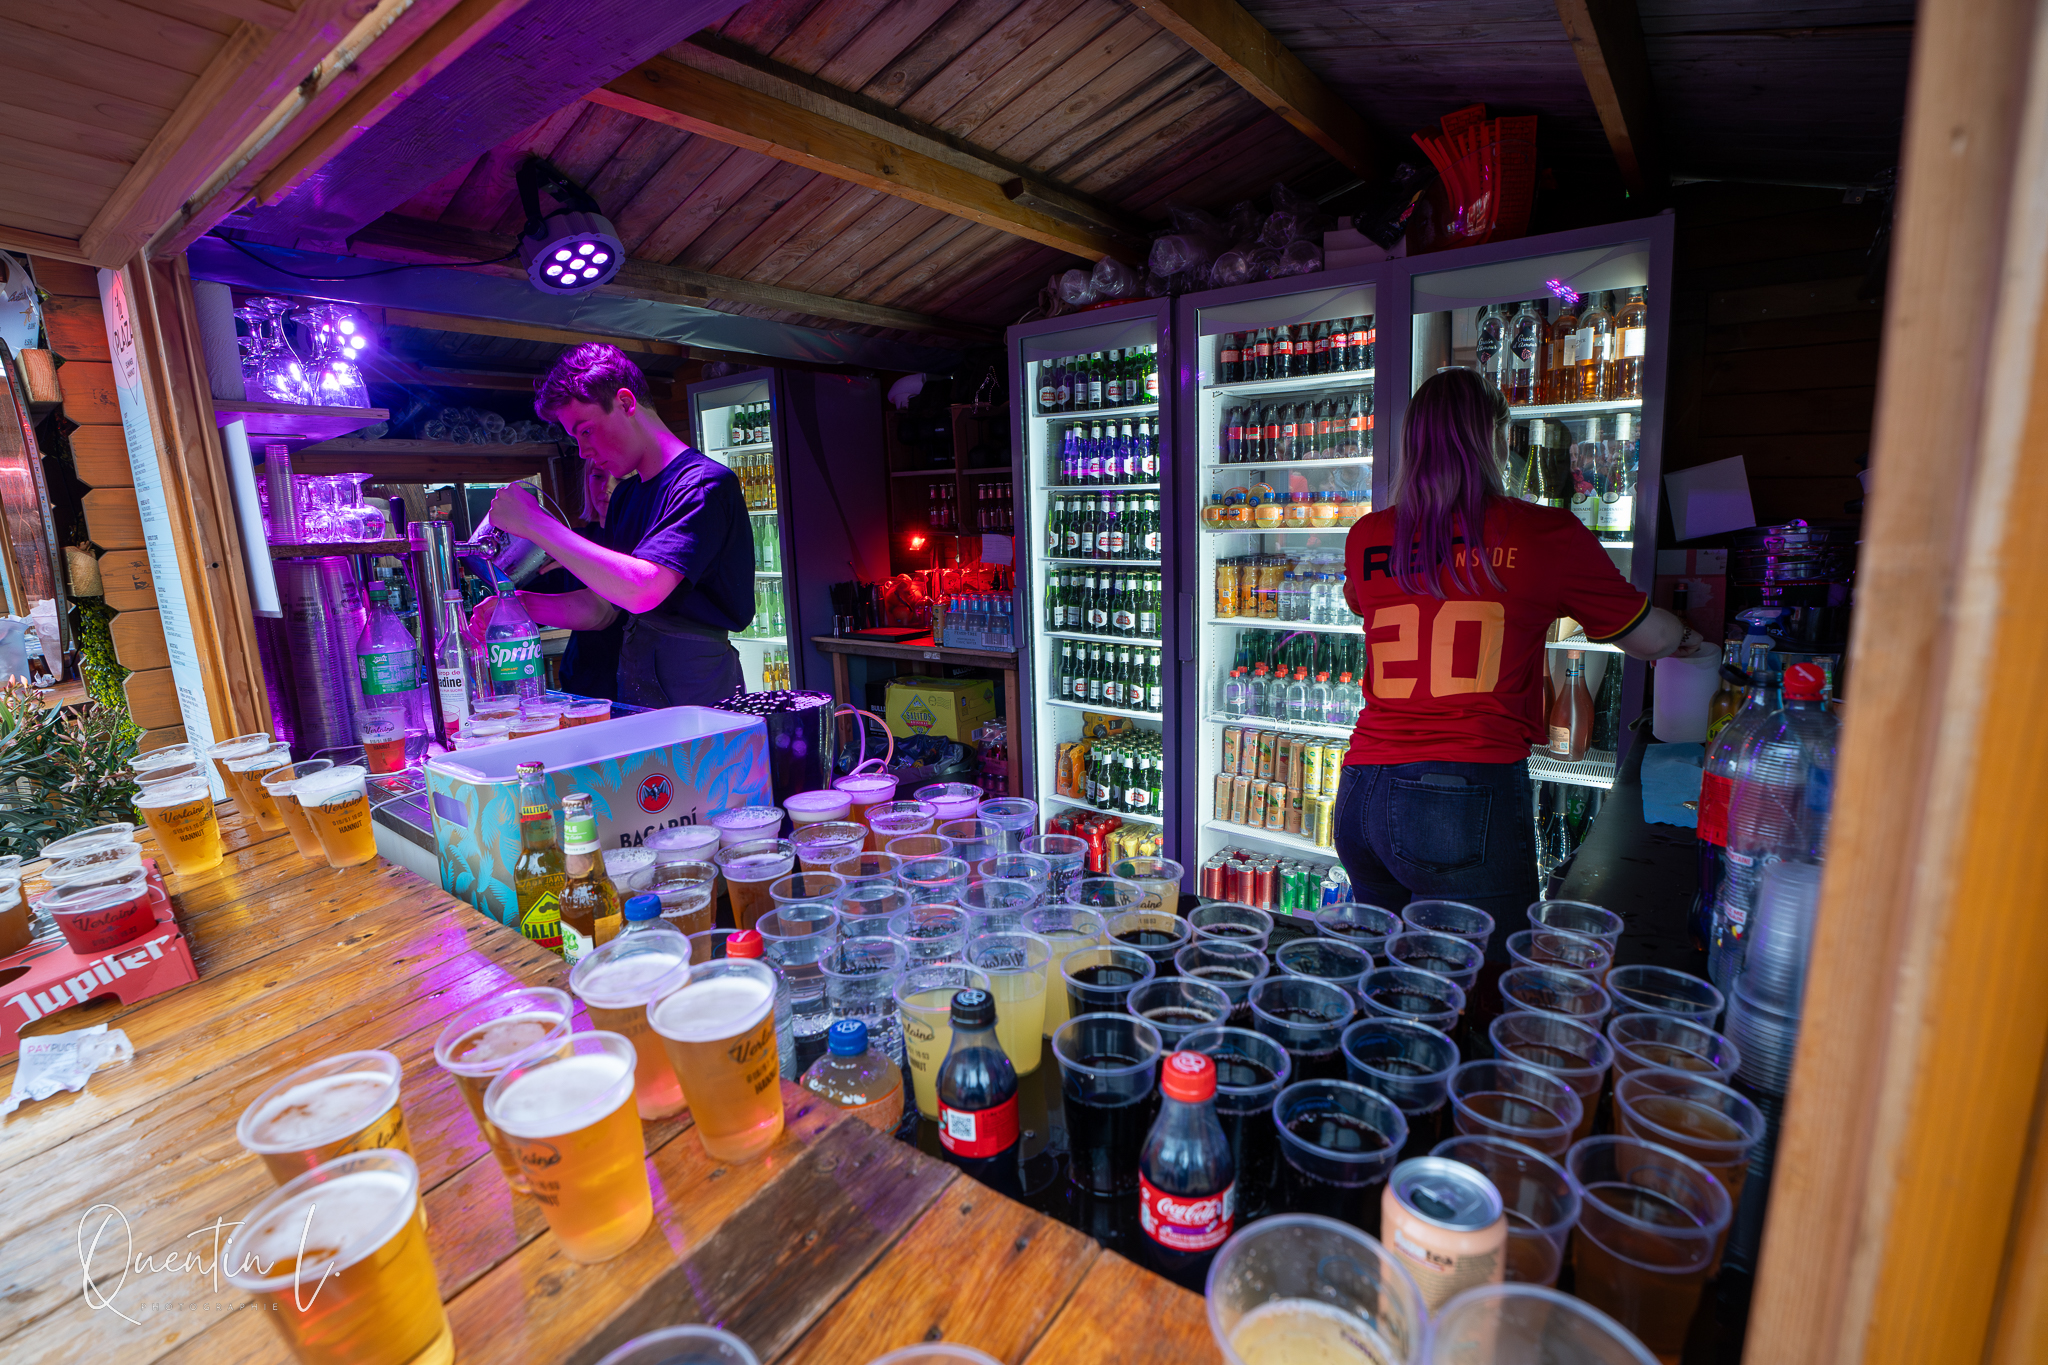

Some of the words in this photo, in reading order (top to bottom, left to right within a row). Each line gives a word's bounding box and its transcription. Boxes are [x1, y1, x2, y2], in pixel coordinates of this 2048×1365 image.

[491, 641, 541, 667] Sprite
[1371, 601, 1505, 698] 20
[906, 711, 932, 721] SALITOS
[159, 803, 206, 823] Verlaine
[319, 796, 363, 814] Verlaine
[522, 804, 548, 815] SALITOS
[180, 828, 205, 842] HANNUT
[339, 820, 363, 834] HANNUT
[524, 920, 562, 939] SALIT
[4, 935, 169, 1033] Jupiler
